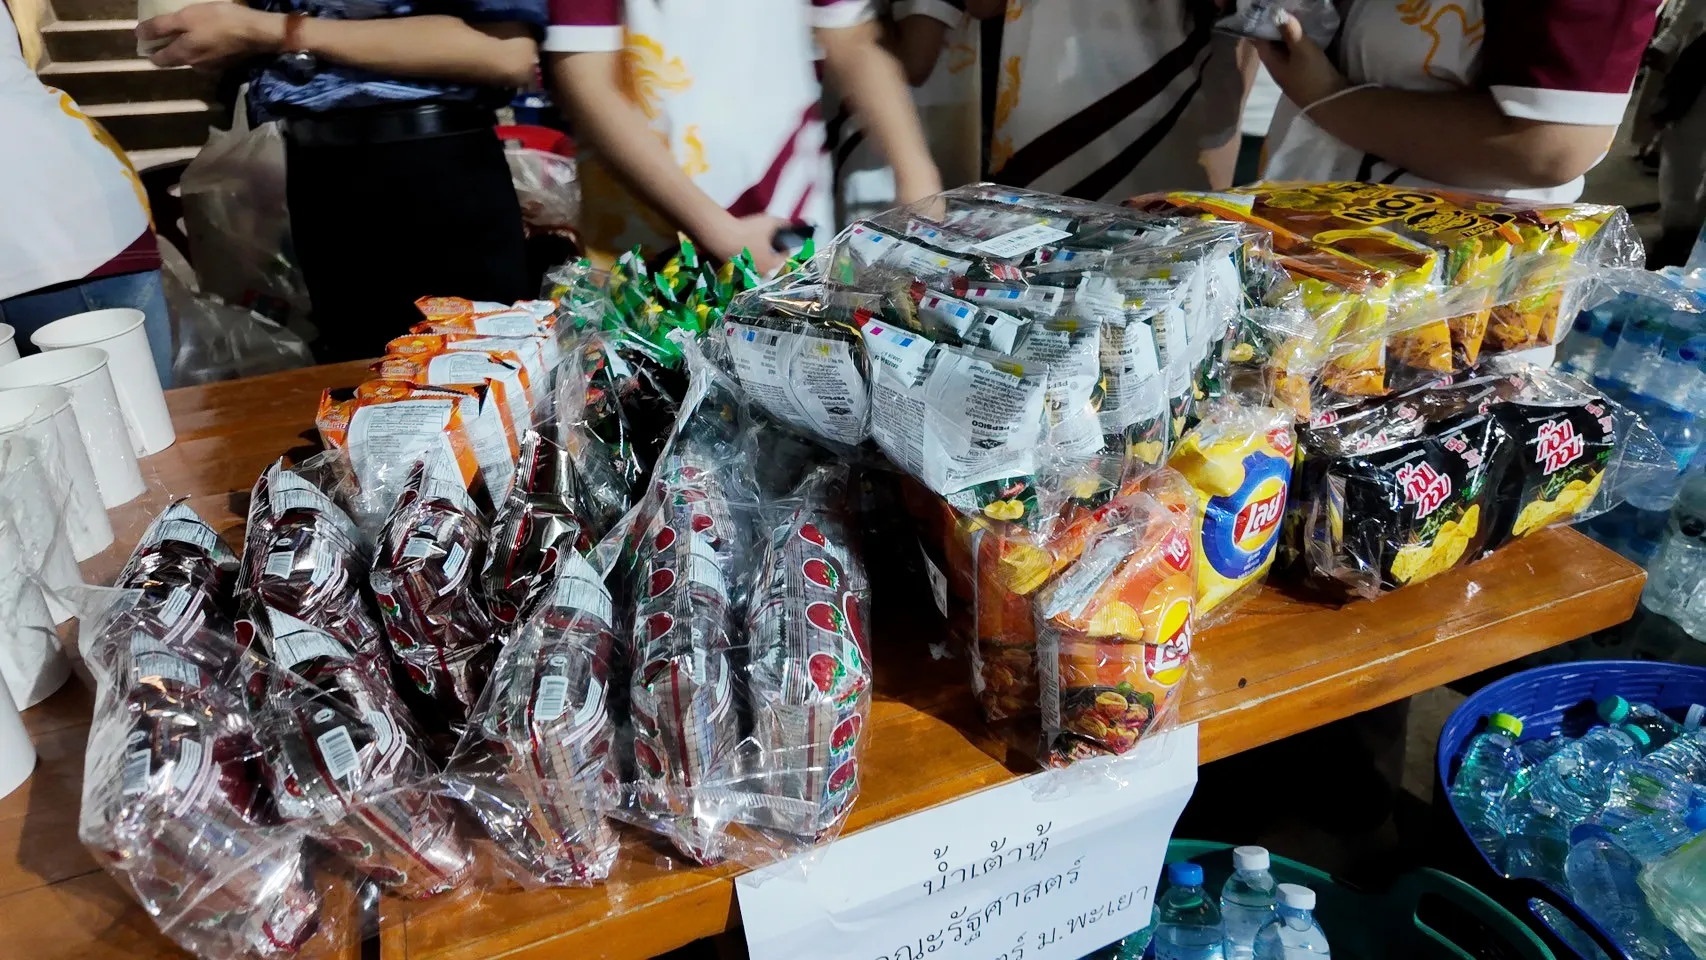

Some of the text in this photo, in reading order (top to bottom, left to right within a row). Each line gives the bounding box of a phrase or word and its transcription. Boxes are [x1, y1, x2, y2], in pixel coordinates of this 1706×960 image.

[971, 420, 1010, 432] PEPSICO
[922, 820, 1053, 896] น้ำเต้าหู้
[1037, 885, 1149, 950] ม.พะเยา
